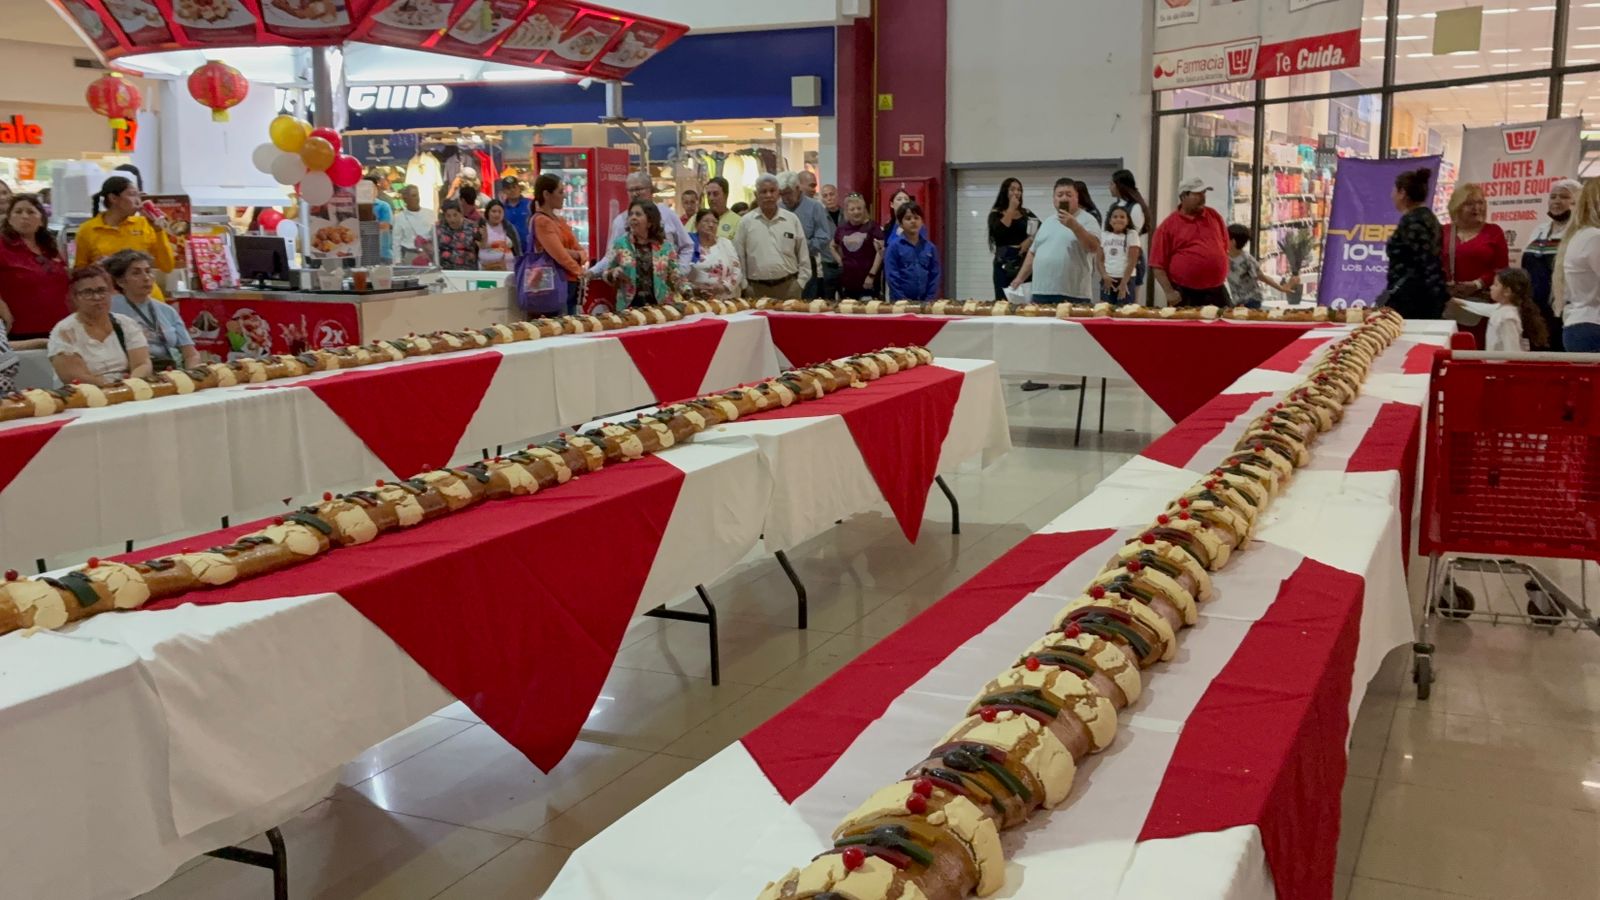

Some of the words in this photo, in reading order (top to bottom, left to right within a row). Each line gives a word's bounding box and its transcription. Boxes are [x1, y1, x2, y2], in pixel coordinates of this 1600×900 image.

[1176, 54, 1225, 74] Farmacia
[1275, 52, 1291, 75] Te
[1297, 44, 1345, 70] Cuida.
[1492, 158, 1532, 179] ÚNETE
[1535, 159, 1545, 176] A
[1524, 176, 1567, 196] EQUI
[1341, 264, 1363, 272] LOS
[319, 325, 345, 343] 2x
